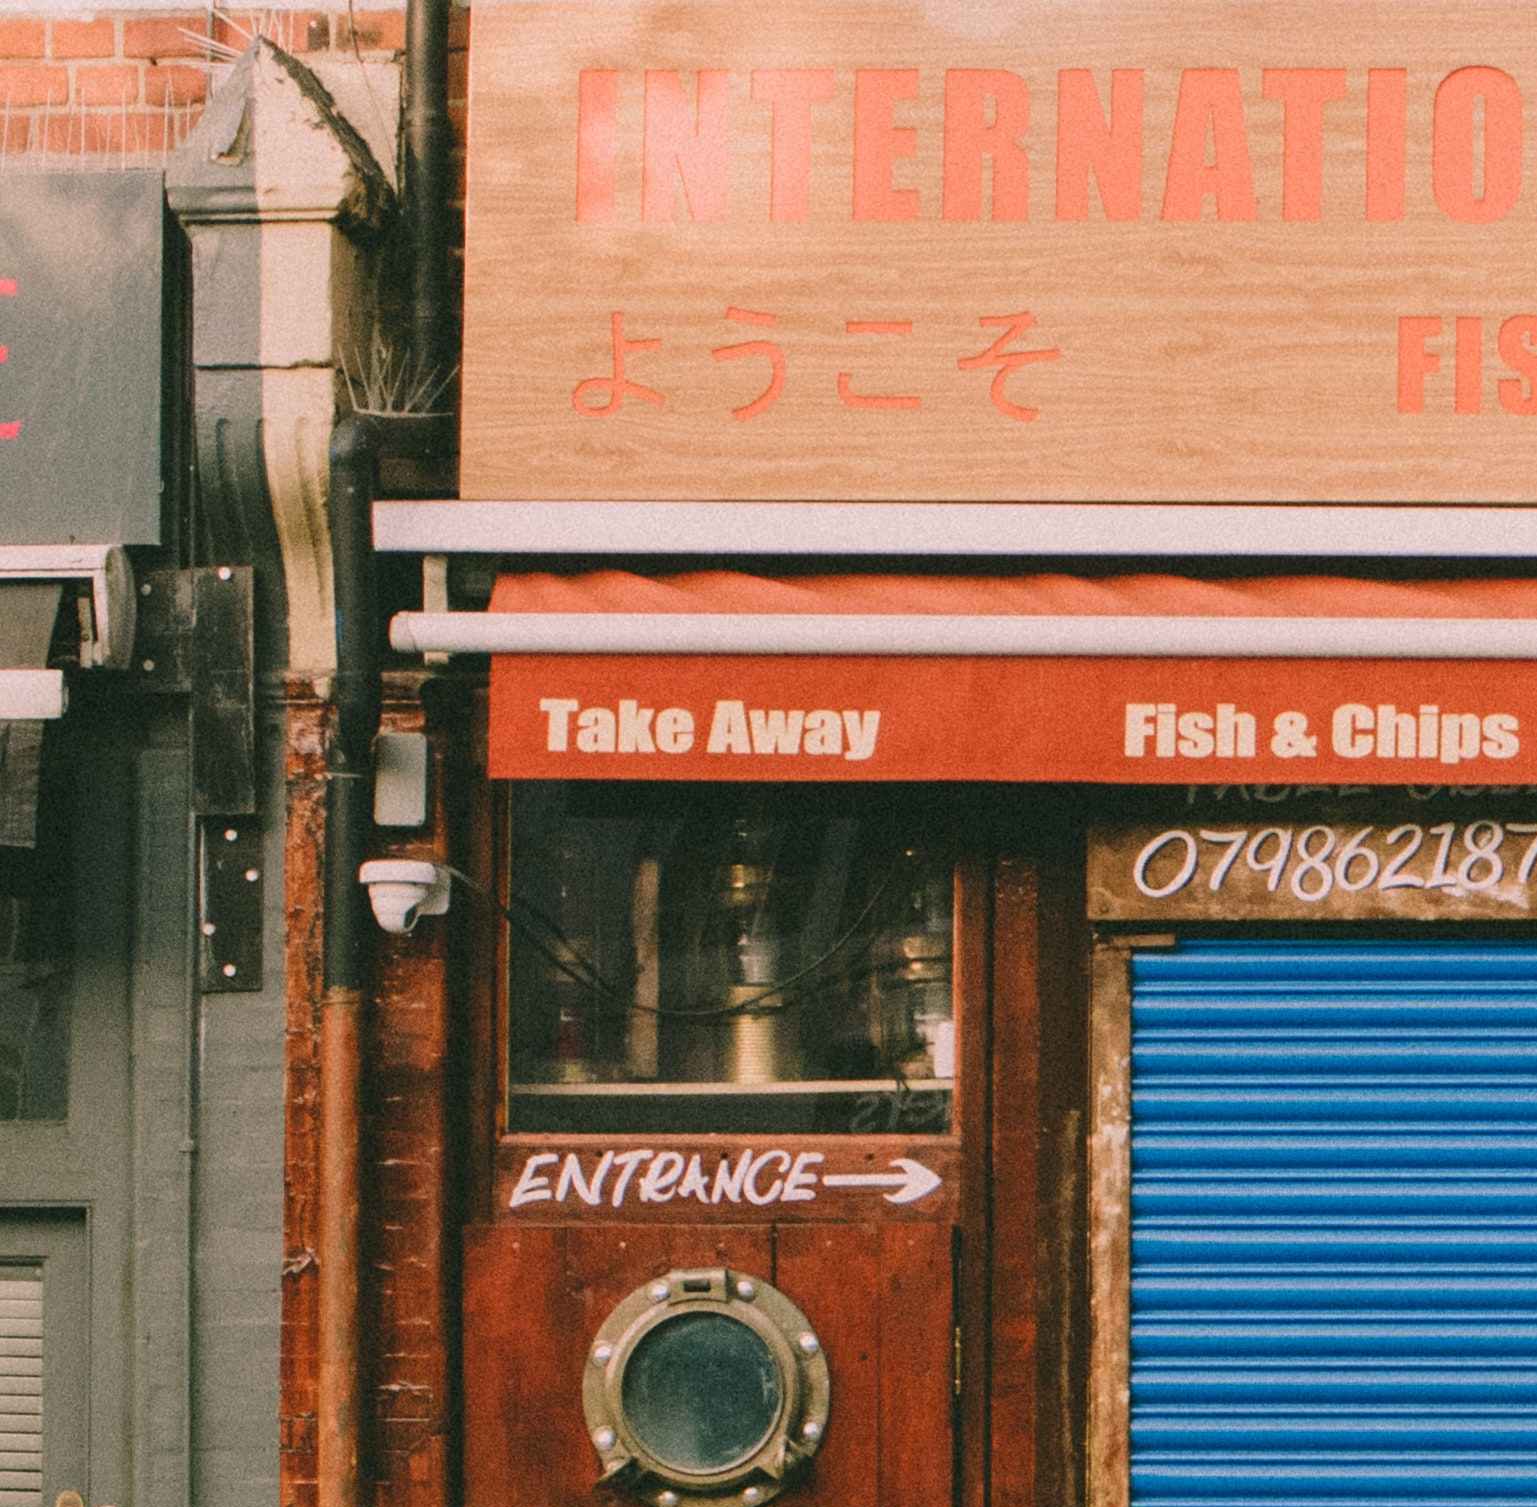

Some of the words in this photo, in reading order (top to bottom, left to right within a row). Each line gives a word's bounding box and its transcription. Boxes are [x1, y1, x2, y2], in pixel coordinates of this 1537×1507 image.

[572, 307, 1061, 422] ようこそ
[540, 699, 693, 753] Take
[709, 701, 880, 760] Away
[1125, 704, 1256, 758] Fish
[1271, 712, 1317, 758] &
[1333, 704, 1519, 764] Chips
[510, 1149, 824, 1207] ENTRANCE
